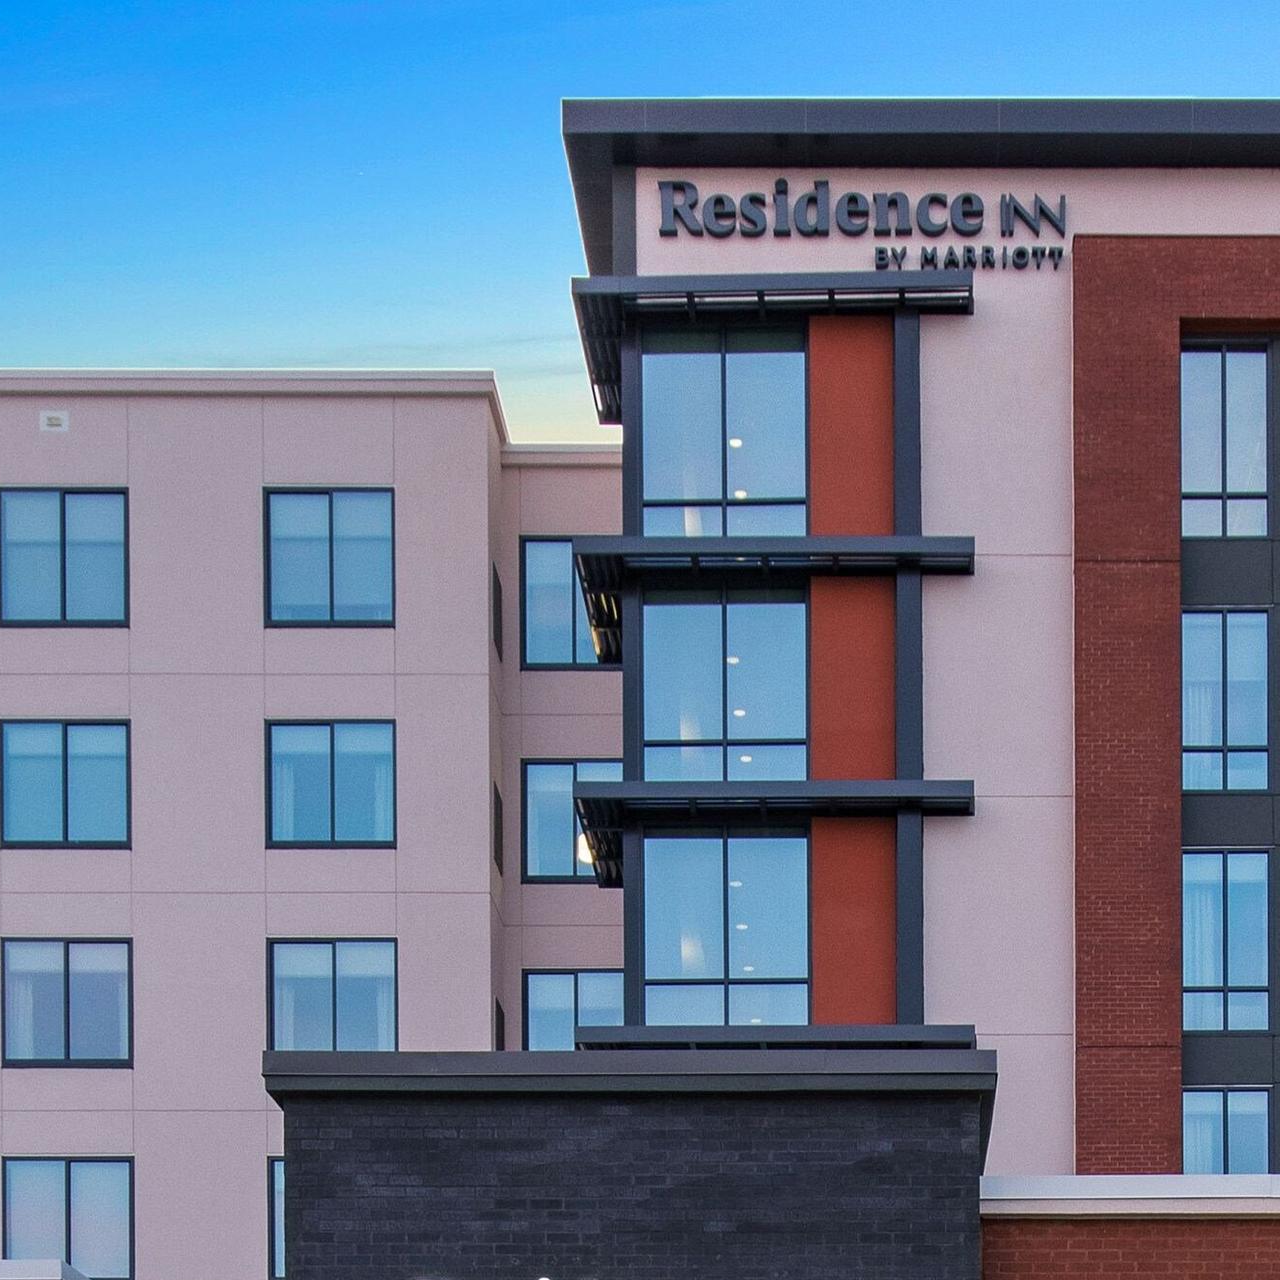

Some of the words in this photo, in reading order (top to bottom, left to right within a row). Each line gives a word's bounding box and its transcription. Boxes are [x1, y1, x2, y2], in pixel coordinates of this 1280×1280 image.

[657, 178, 984, 238] Residence
[1000, 192, 1066, 238] INN
[874, 246, 908, 270] BY
[920, 245, 1065, 271] MARRIOTT
